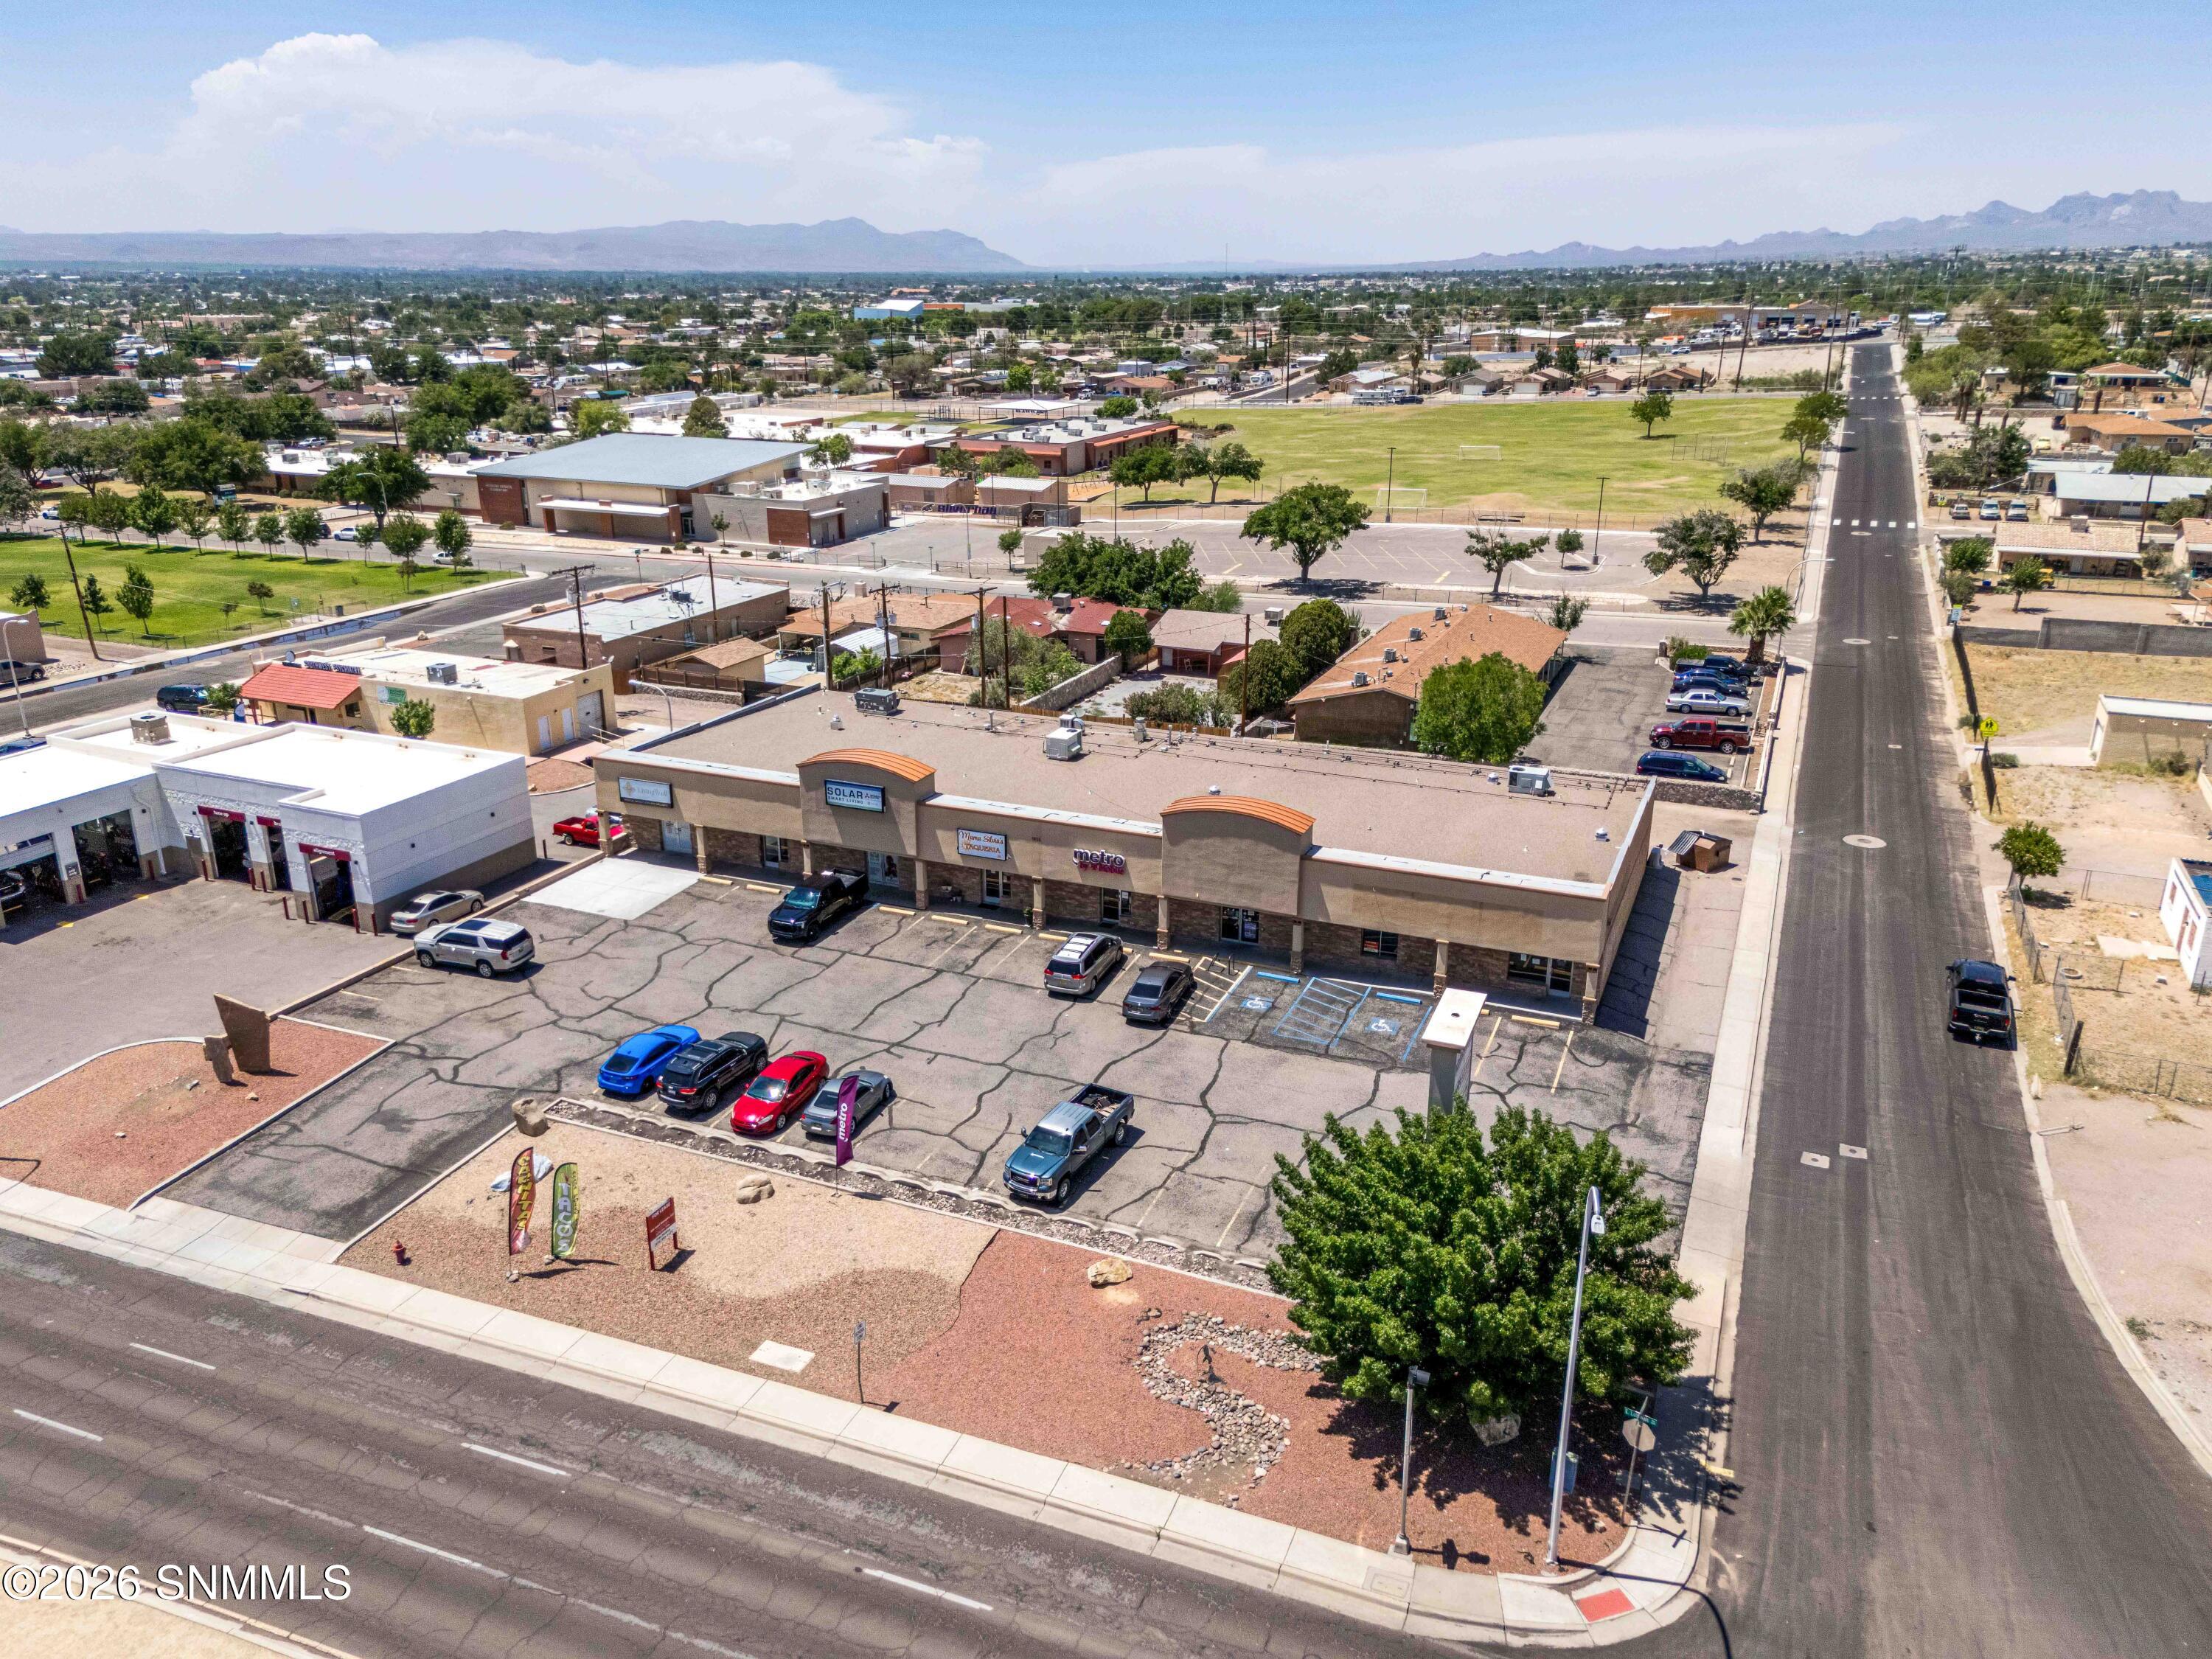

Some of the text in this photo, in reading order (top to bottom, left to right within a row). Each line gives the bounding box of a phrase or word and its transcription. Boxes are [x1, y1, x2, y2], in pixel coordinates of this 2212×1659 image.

[304, 661, 361, 674] SOUTHWEST PSYCHIATRY
[827, 787, 863, 799] SOLAR
[1073, 848, 1125, 867] metro
[838, 1102, 849, 1142] metro
[517, 1155, 533, 1230] CARNITAS
[557, 1183, 574, 1251] TACOS
